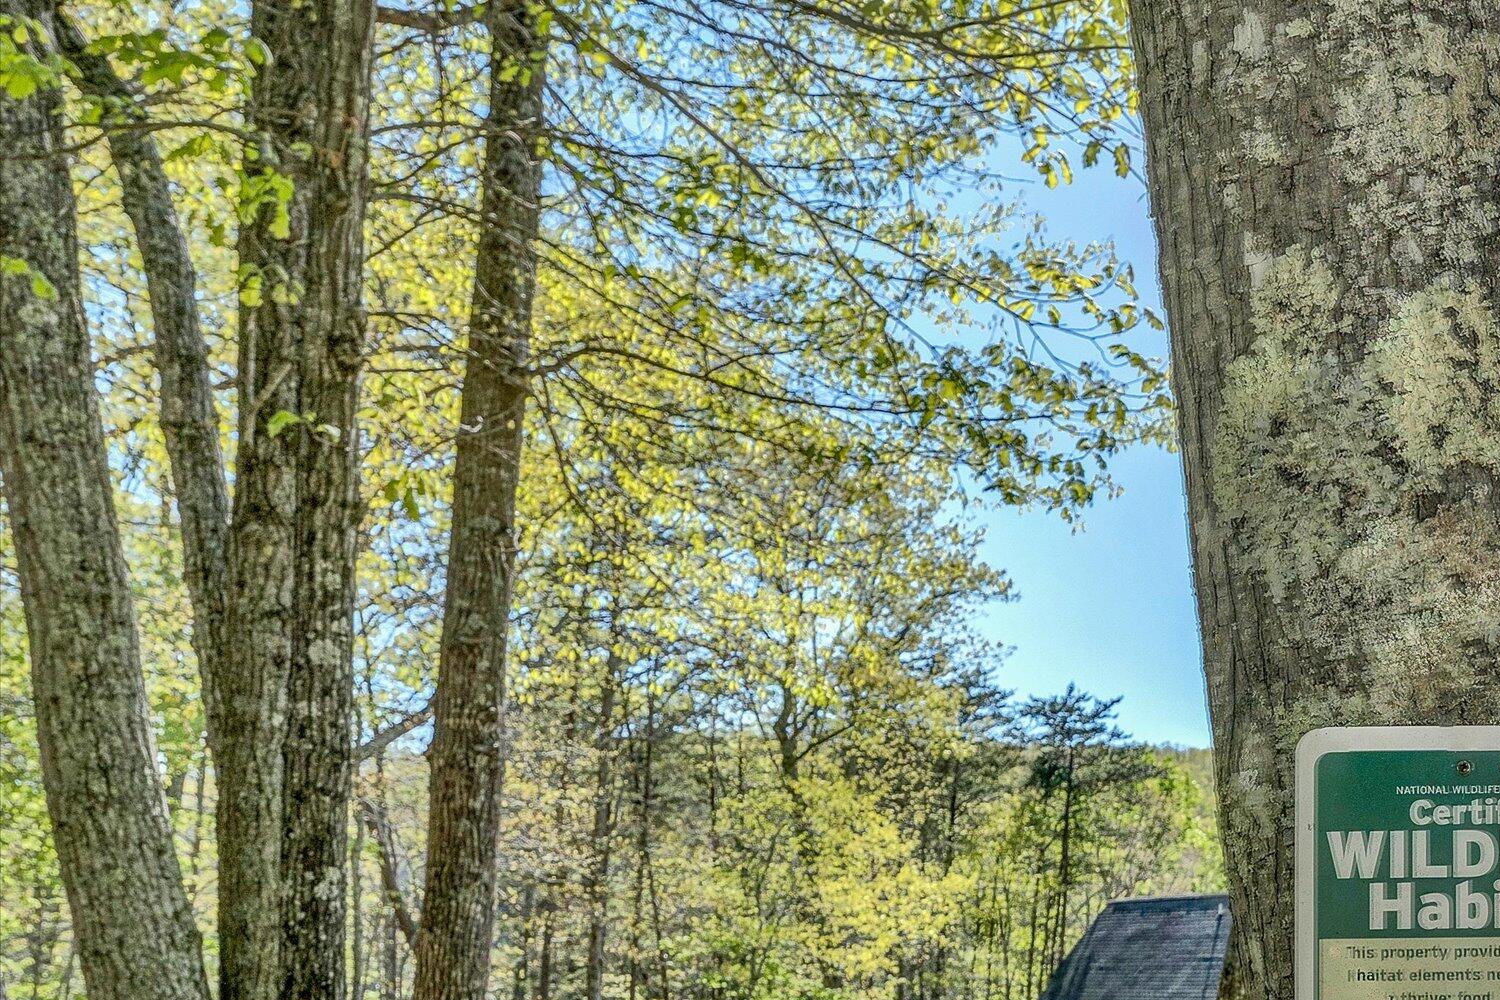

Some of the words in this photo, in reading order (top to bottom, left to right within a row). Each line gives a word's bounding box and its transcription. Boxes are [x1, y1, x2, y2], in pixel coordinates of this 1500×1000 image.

[1396, 785, 1450, 794] NATIONAL
[1452, 784, 1500, 794] WILDLIFE
[1381, 945, 1448, 960] property
[1409, 968, 1481, 981] elements
